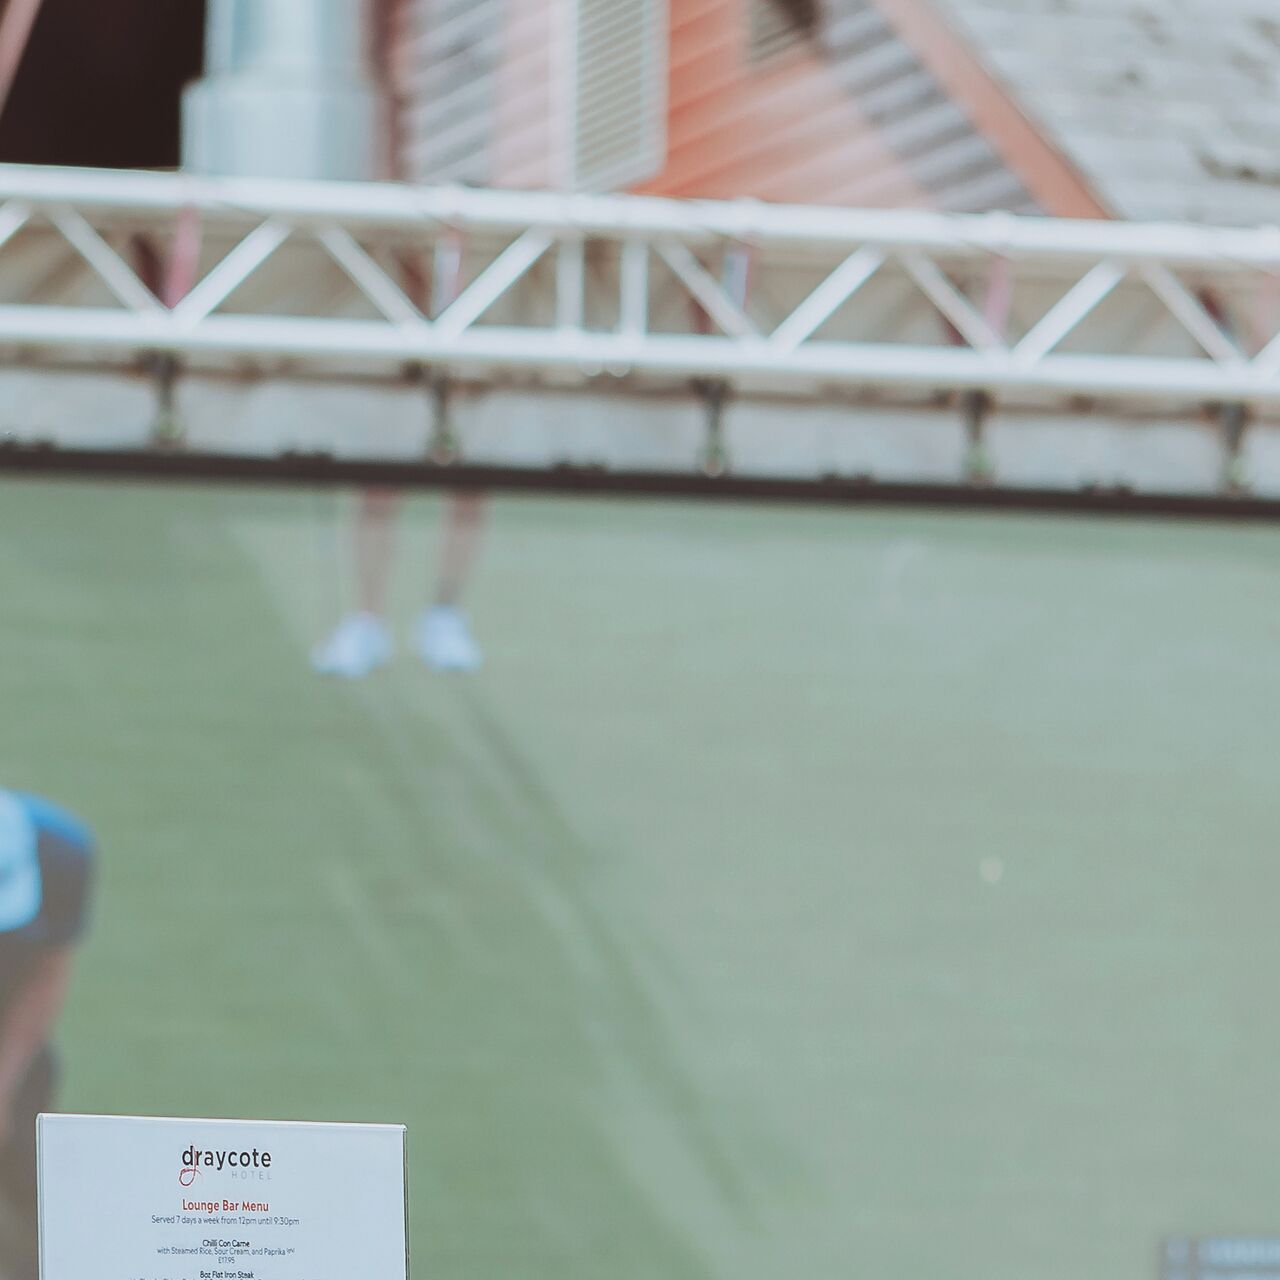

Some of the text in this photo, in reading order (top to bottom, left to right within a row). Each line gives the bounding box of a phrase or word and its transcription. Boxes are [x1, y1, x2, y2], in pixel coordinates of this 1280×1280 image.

[180, 1145, 272, 1173] draycote
[231, 1171, 272, 1180] HOTEL
[182, 1199, 269, 1214] Lounge Bar Menu
[152, 1215, 175, 1224] Served
[177, 1215, 180, 1224] 7
[182, 1215, 197, 1225] days
[203, 1216, 220, 1224] week
[221, 1216, 237, 1225] from
[239, 1216, 257, 1226] 12pm
[258, 1216, 273, 1225] until
[274, 1216, 300, 1226] 9:30pm
[238, 1271, 254, 1279] Steak
